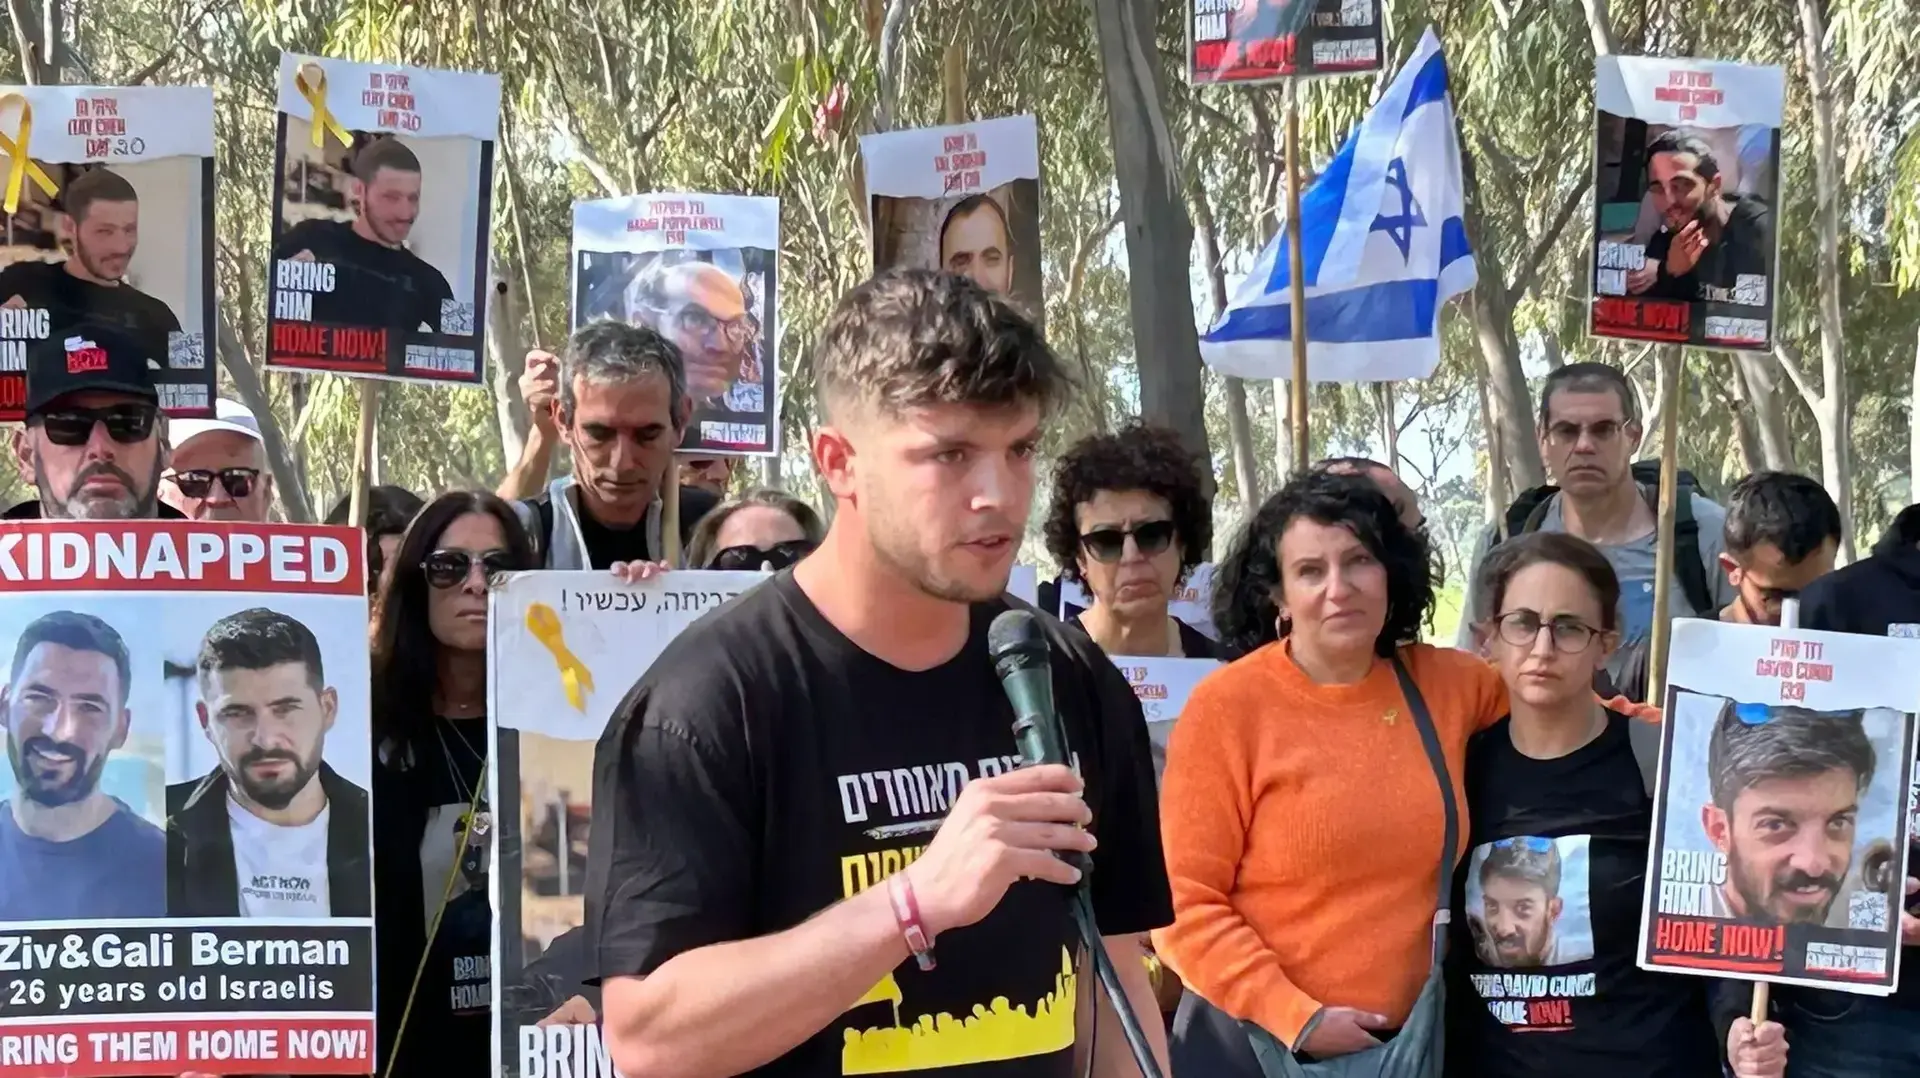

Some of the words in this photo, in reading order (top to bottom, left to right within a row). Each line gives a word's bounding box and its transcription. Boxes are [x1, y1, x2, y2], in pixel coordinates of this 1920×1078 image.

[113, 137, 145, 155] 20
[277, 260, 336, 292] BRING
[275, 290, 313, 322] HIM
[0, 308, 50, 339] RING
[0, 341, 28, 371] IM
[273, 324, 327, 356] HOME
[332, 328, 387, 363] NOW!
[575, 592, 647, 613] עכשיו
[1662, 850, 1728, 885] BRING
[1658, 881, 1703, 917] HIM
[0, 933, 173, 971] Ziv&Gali
[191, 932, 349, 967] Berman
[1656, 918, 1716, 953] HOME
[1721, 924, 1784, 960] NOW!
[9, 979, 46, 1006] 26
[59, 980, 146, 1009] years
[158, 976, 207, 1001] old
[220, 975, 335, 1001] Israelis
[0, 1034, 78, 1066] RING
[88, 1031, 177, 1062] THEM
[188, 1029, 279, 1060] HOME
[288, 1029, 367, 1059] NOW!
[519, 1023, 624, 1078] BRIN
